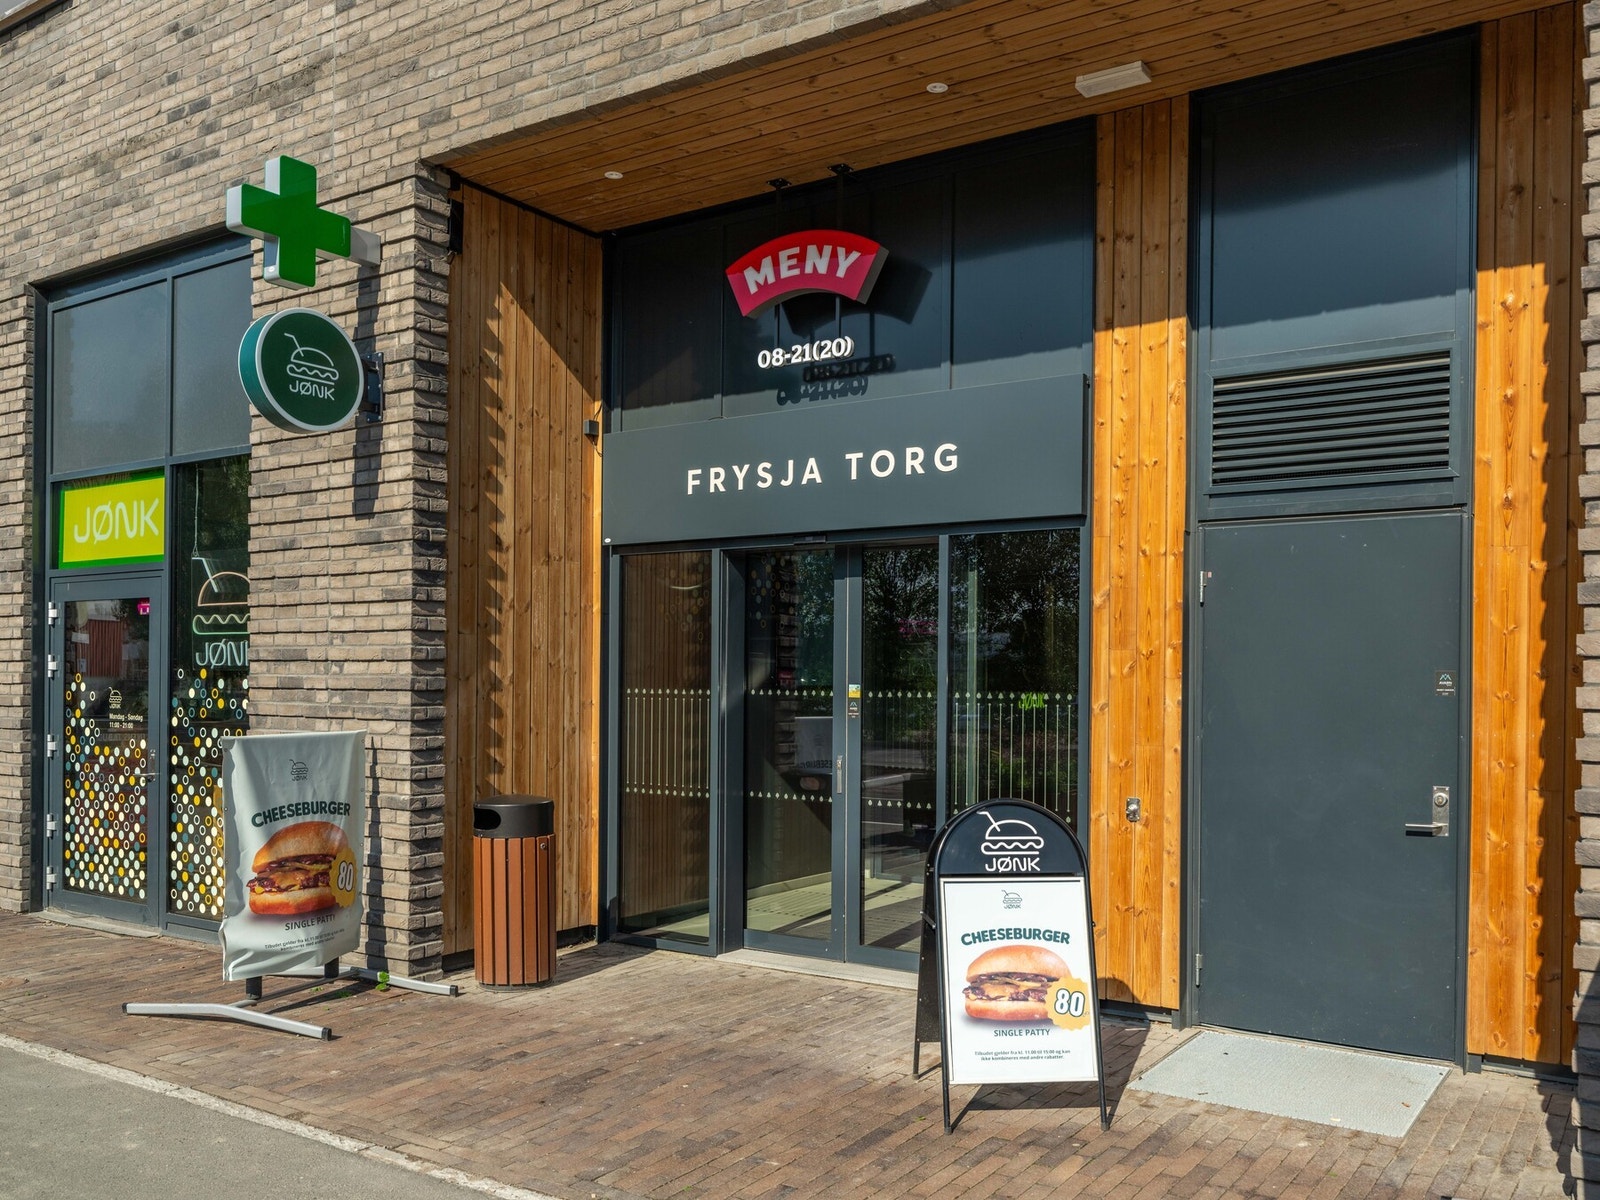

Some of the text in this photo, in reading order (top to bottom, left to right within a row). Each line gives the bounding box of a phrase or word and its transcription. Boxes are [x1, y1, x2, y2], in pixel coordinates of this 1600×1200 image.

[743, 244, 862, 295] MENY
[757, 336, 854, 369] 08-21(20)
[289, 380, 335, 401] JØNK
[687, 443, 958, 495] FRYSJA TORG
[73, 497, 160, 545] JØNK
[291, 774, 308, 782] JØNK
[251, 800, 351, 828] CHEESEBURGER
[337, 861, 354, 892] 80
[985, 857, 1041, 873] JØNK
[285, 918, 315, 931] SINGLE
[961, 927, 1071, 946] CHEESEBURGER
[1054, 988, 1086, 1018] 80
[993, 1028, 1051, 1037] SINGLE PATTY
